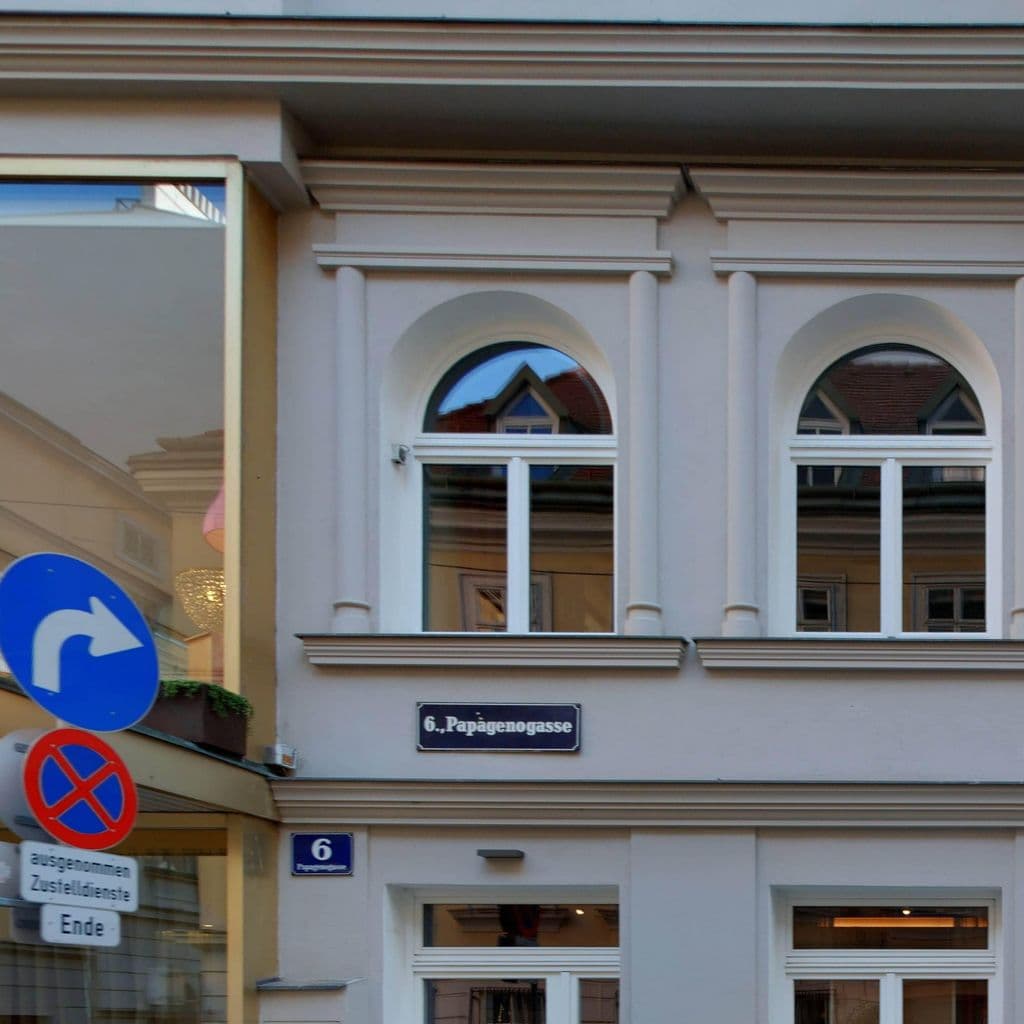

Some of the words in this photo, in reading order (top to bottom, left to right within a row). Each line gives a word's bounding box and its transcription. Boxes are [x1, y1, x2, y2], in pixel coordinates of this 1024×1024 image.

[311, 838, 332, 860] 6
[30, 853, 130, 878] ausgenommen
[31, 874, 130, 901] Zustelldienste
[61, 914, 104, 936] Ende
